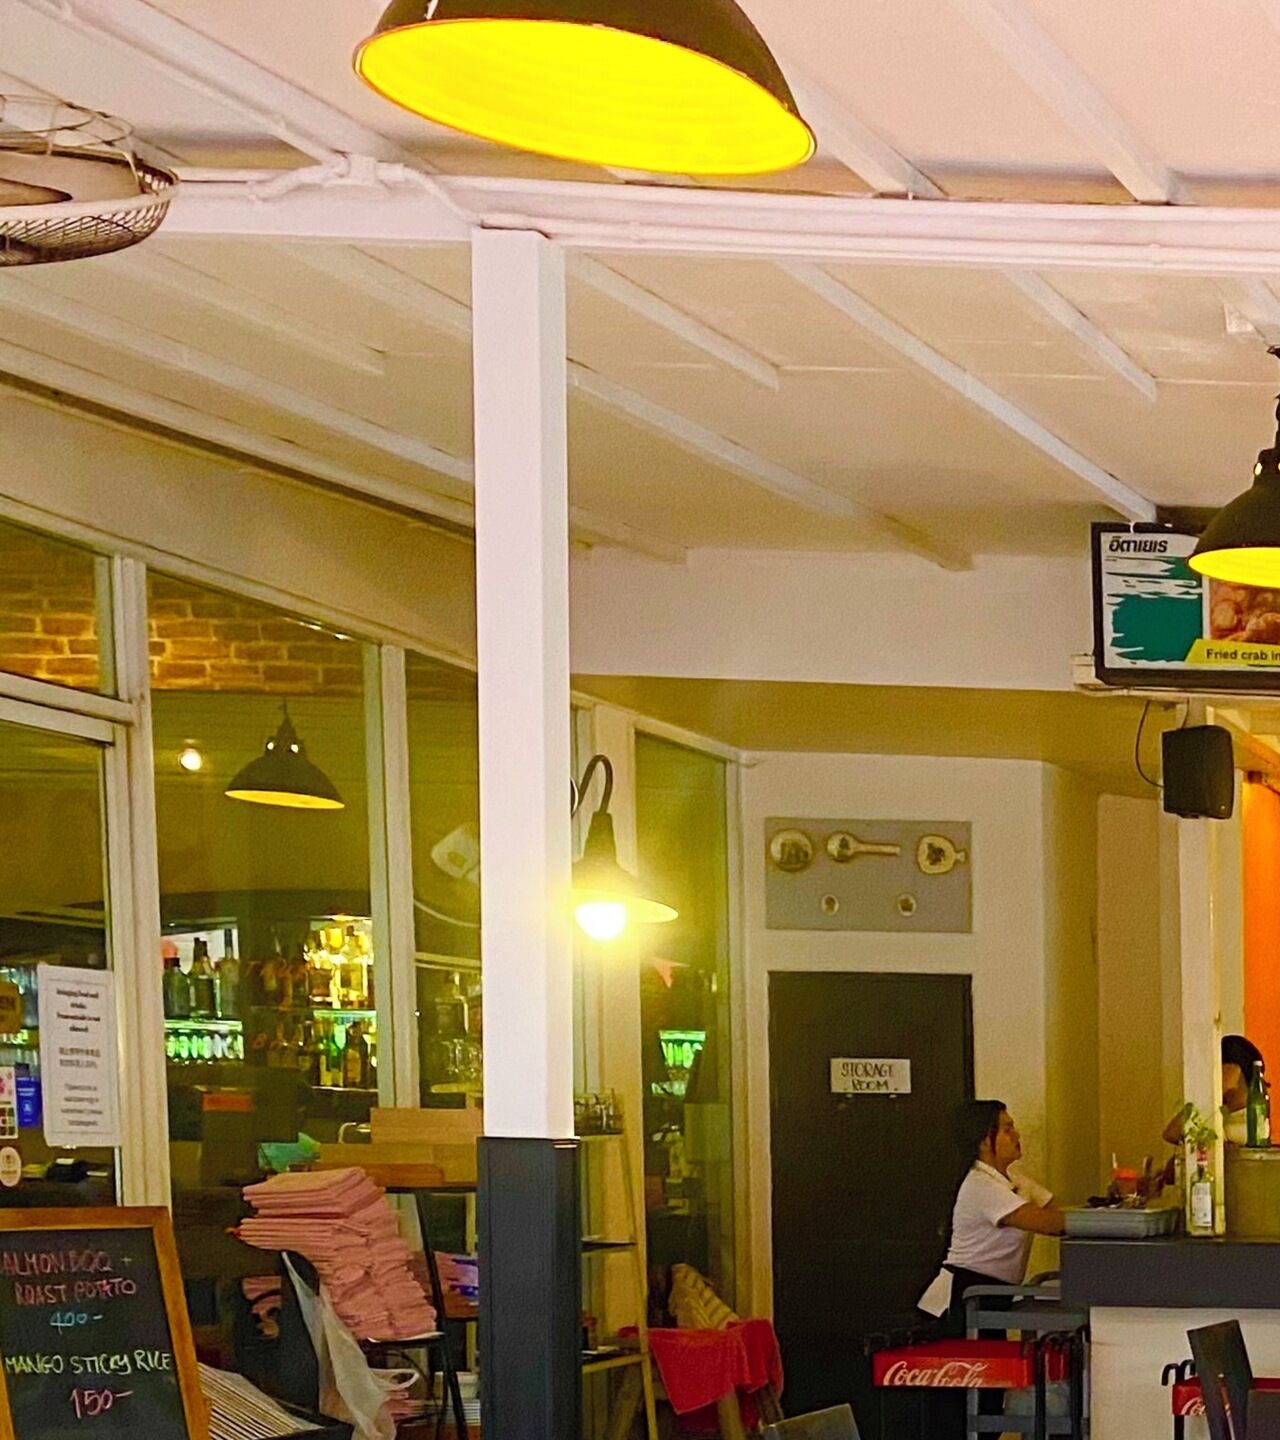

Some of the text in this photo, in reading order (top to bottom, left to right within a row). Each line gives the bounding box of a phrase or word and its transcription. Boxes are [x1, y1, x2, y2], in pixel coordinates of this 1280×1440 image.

[1205, 648, 1238, 660] Fried
[1240, 649, 1268, 661] crab
[841, 1062, 893, 1078] STORAGE
[0, 1251, 65, 1275] ALMON
[15, 1282, 67, 1305] ROAST
[5, 1354, 64, 1374] MANGO
[133, 1349, 171, 1371] RICE
[883, 1360, 988, 1388] Coca-Cola
